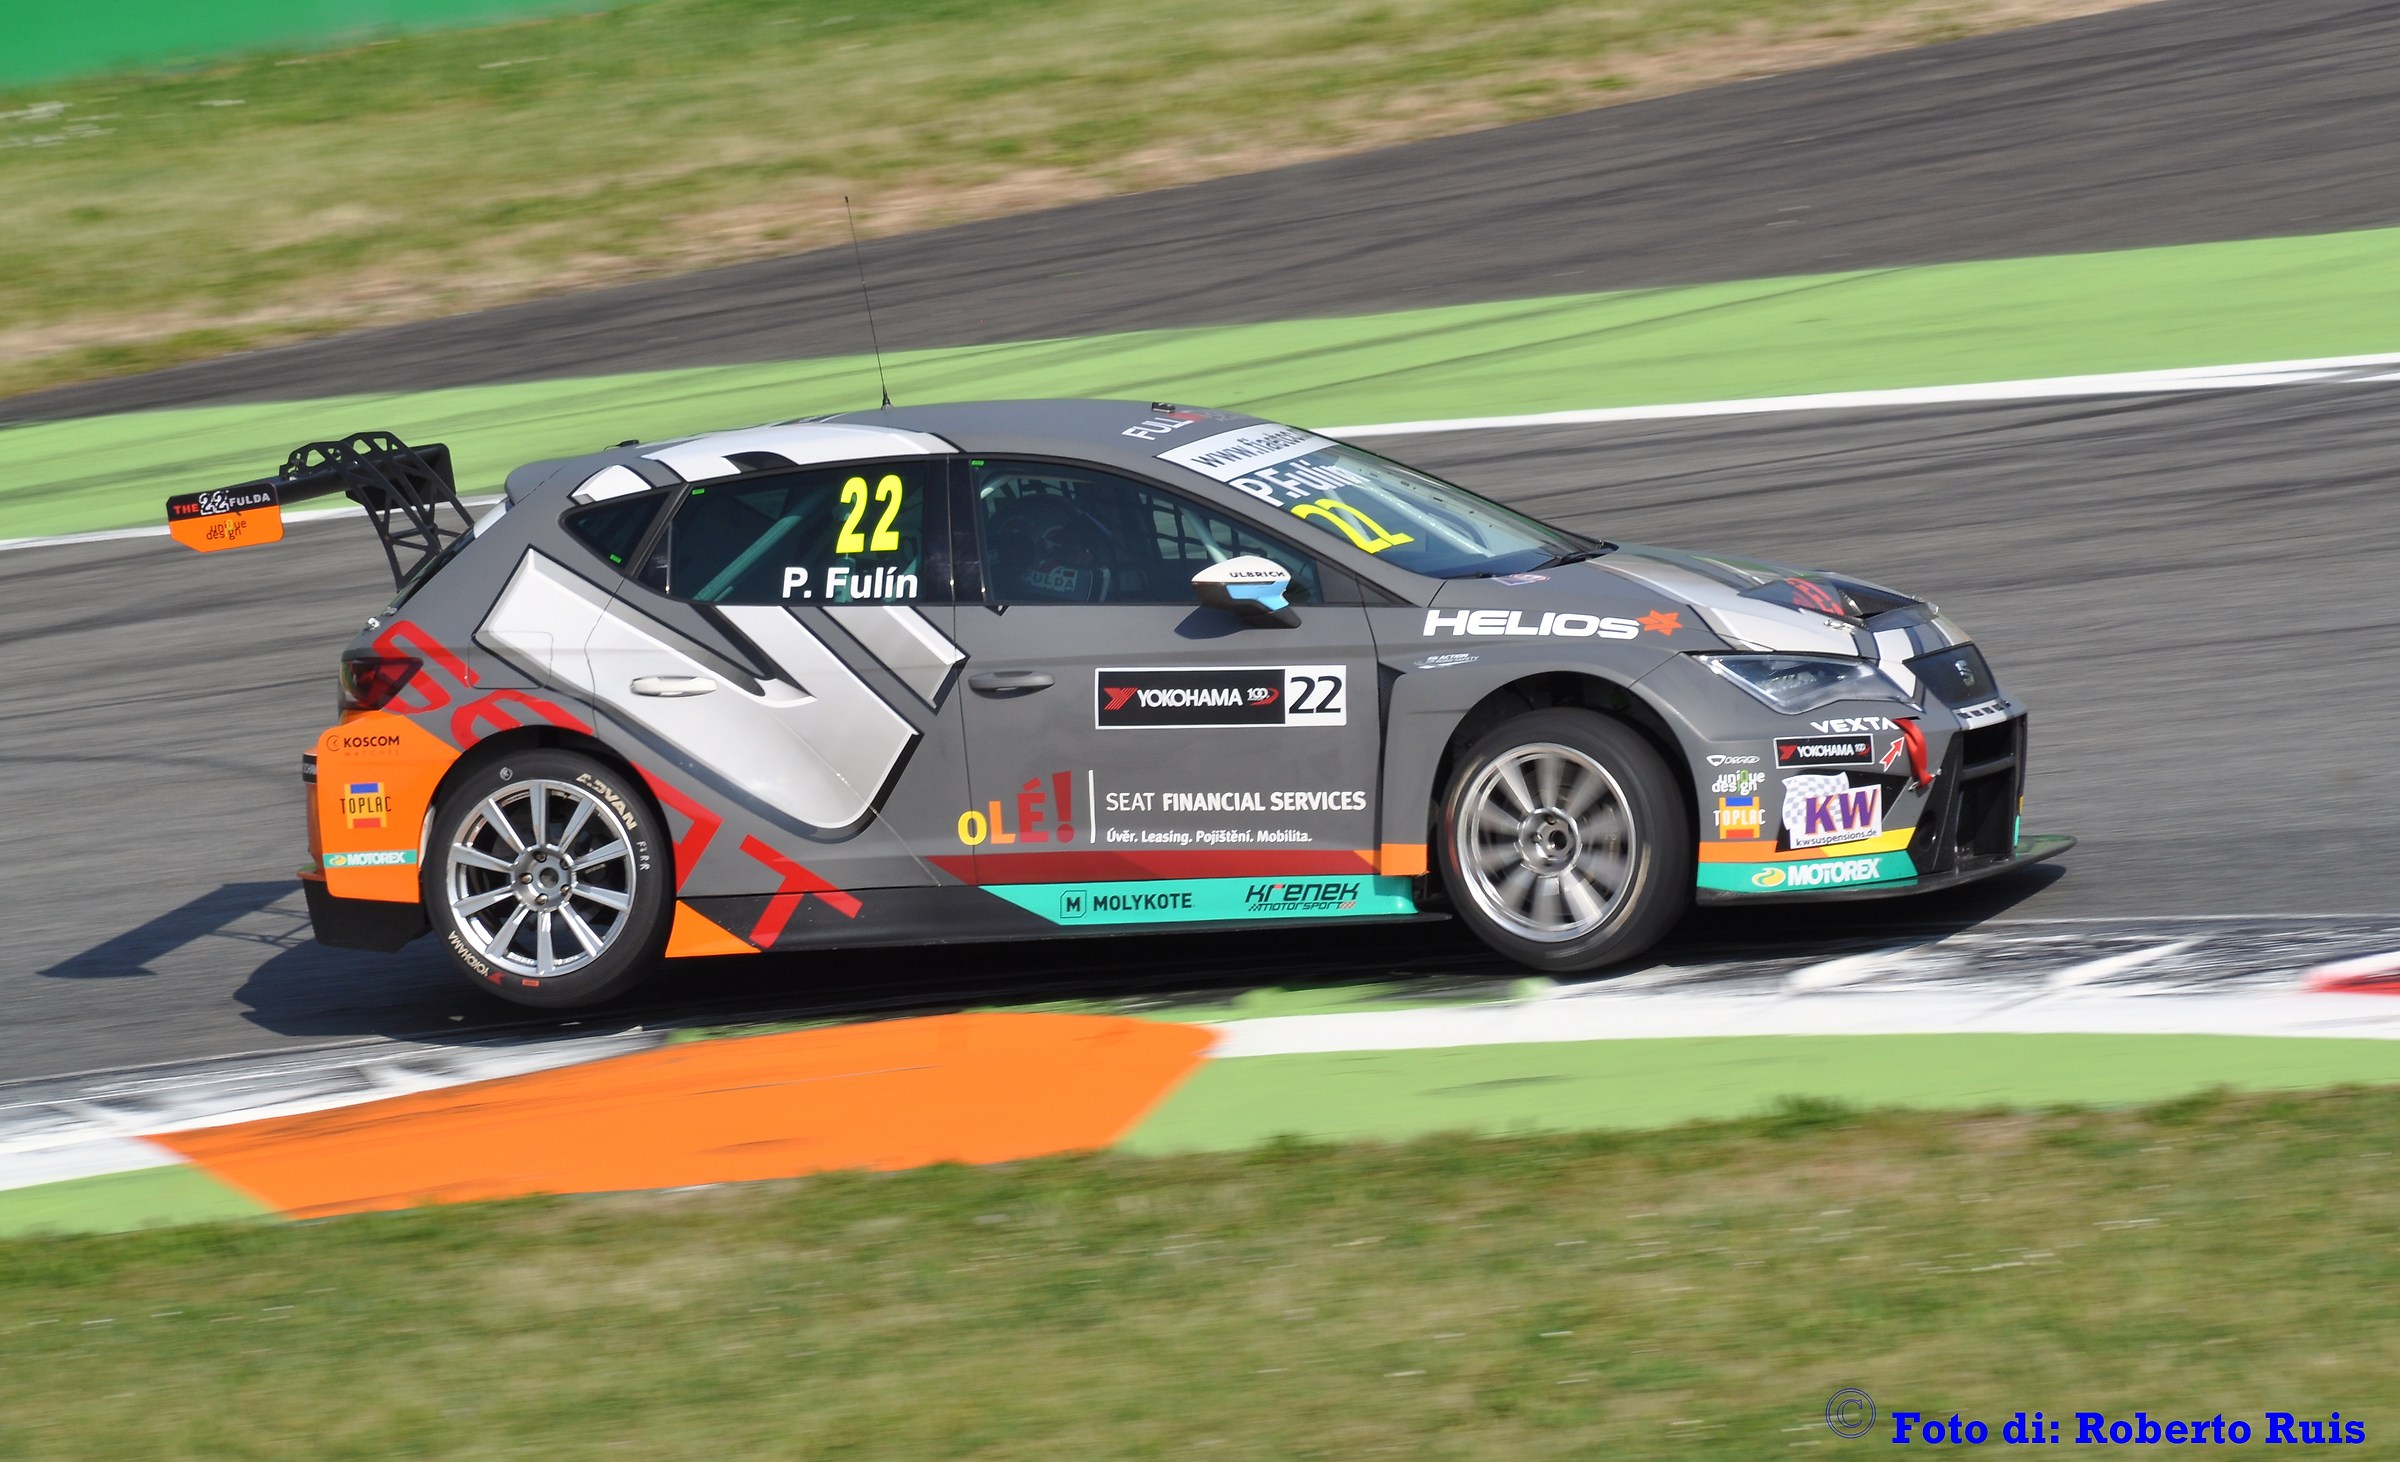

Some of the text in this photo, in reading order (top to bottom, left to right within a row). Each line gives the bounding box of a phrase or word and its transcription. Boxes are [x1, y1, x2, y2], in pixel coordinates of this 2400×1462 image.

[173, 503, 199, 515] THE
[228, 492, 271, 507] FULDA
[835, 474, 903, 554] 22
[1290, 498, 1415, 554] 22
[782, 566, 918, 599] P. Fulín
[1229, 571, 1286, 579] ULBRICH
[1423, 609, 1640, 640] HELIOS
[1137, 687, 1244, 708] YOKOHAMA
[1288, 675, 1343, 714] 22
[343, 735, 400, 748] KOSCOM
[1797, 743, 1855, 758] YOKOHAMA
[340, 796, 392, 814] TOPLAC
[575, 773, 638, 831] ADVAN
[1106, 790, 1367, 812] SEAT FINANCIAL SERVICES
[1804, 788, 1879, 836] KW
[1713, 808, 1766, 827] TOPLAC
[1106, 826, 1313, 846] Úvěr. Leasing. Pojištění. Mobilita.
[1796, 829, 1877, 847] kwsuspensions.de
[346, 851, 406, 866] MOTOREX
[1787, 857, 1881, 887] MOTOREX
[1093, 892, 1193, 912] MOLYKOTE
[448, 931, 490, 978] YOKOHAMA
